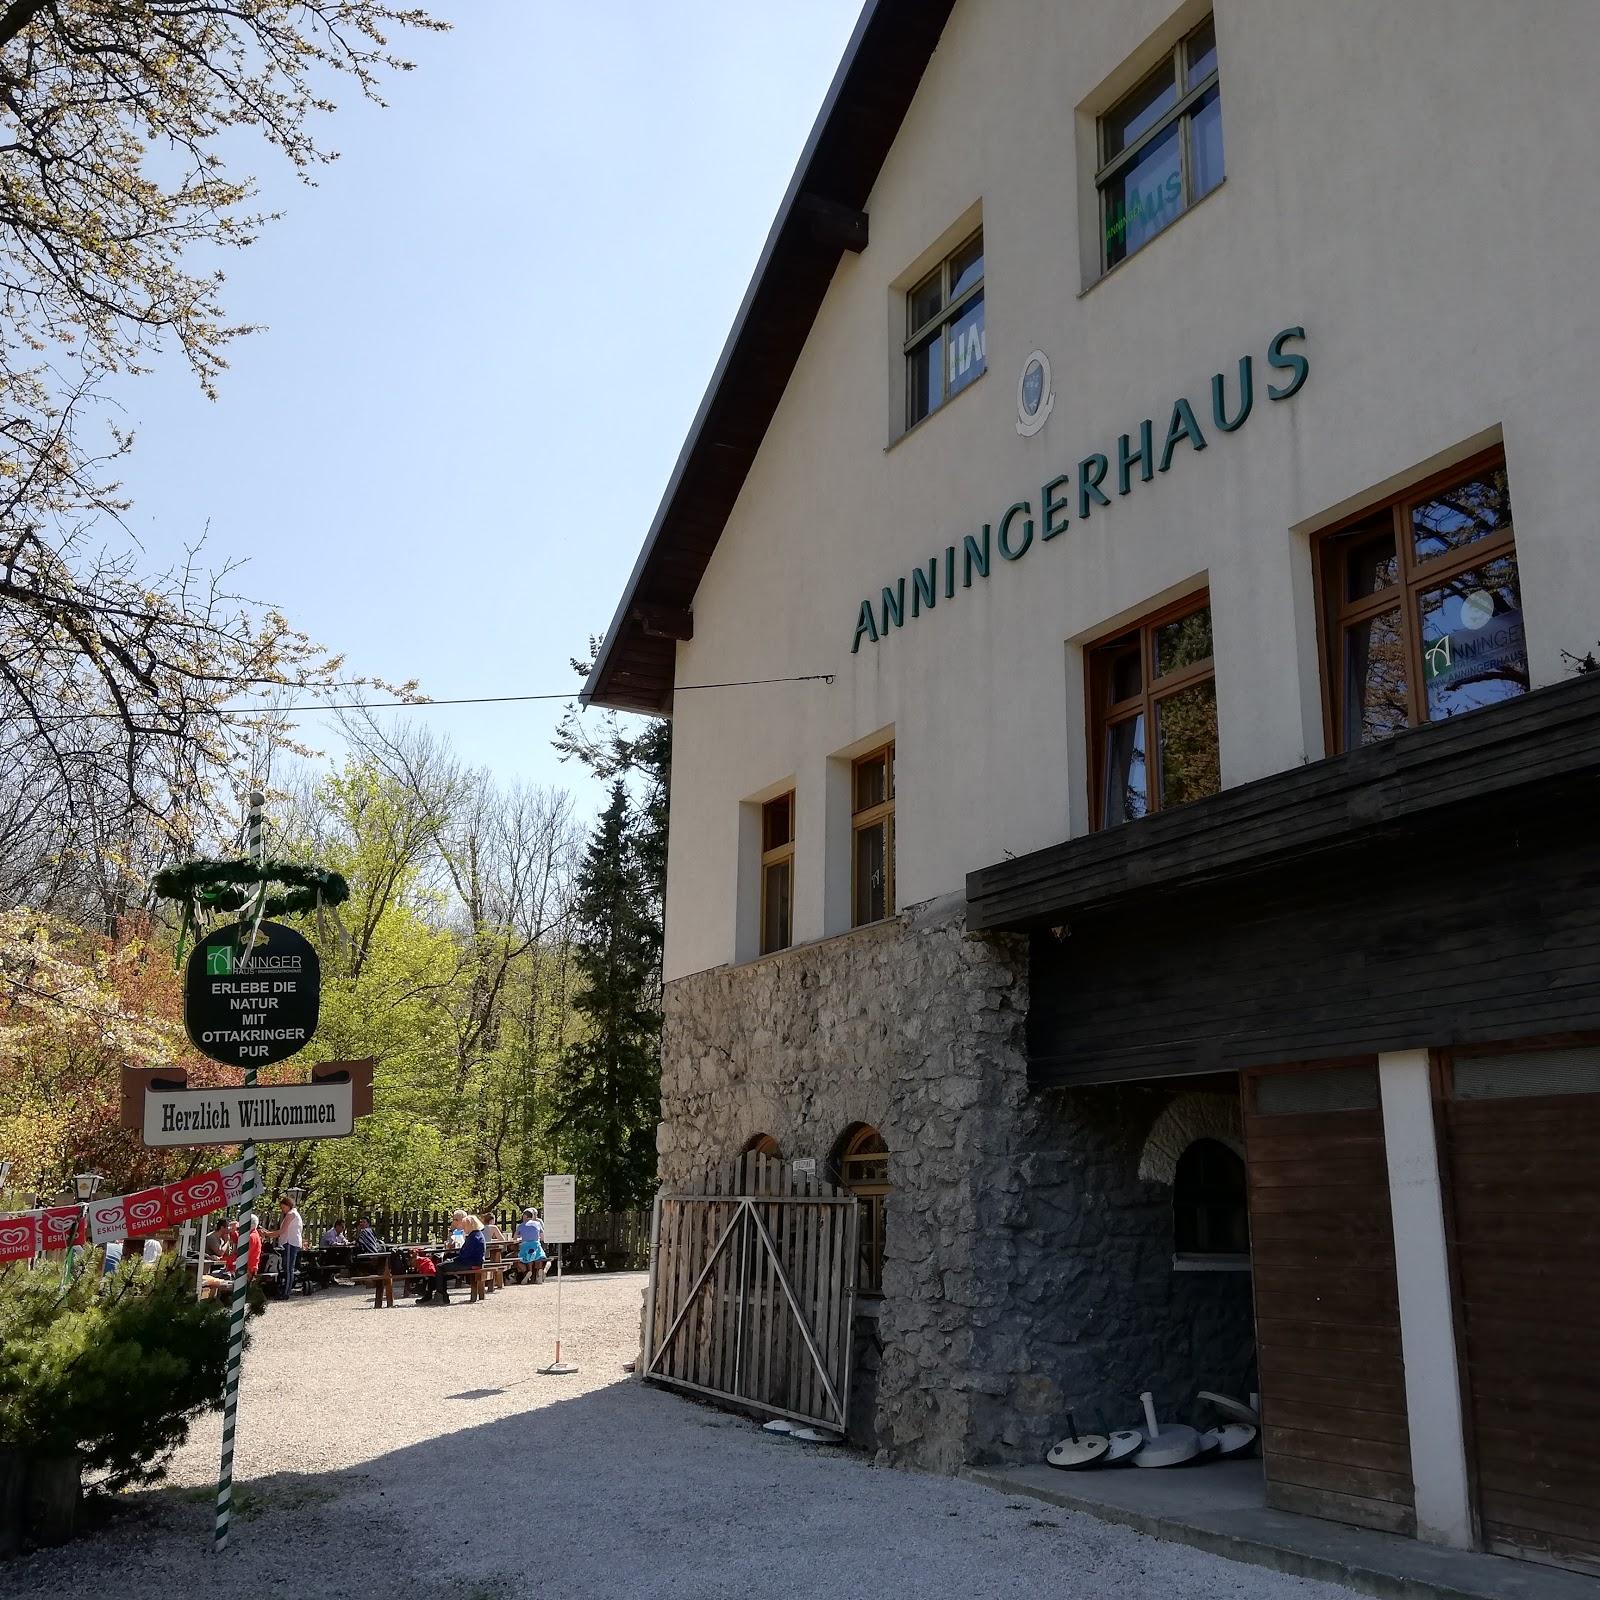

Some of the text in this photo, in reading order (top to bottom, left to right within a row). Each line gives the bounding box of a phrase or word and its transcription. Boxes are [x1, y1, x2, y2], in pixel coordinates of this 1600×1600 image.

[850, 326, 1310, 654] ANNINGERHAUS
[211, 981, 297, 994] ERLEBE DIE
[230, 997, 279, 1010] NATUR
[242, 1013, 267, 1025] MIT
[201, 1028, 305, 1043] OTTAKRINGER
[239, 1045, 270, 1057] PUR
[161, 1098, 336, 1132] Herzlich Willkommen
[191, 1196, 221, 1211] ESKIMO
[131, 1216, 163, 1230] ESKIMO
